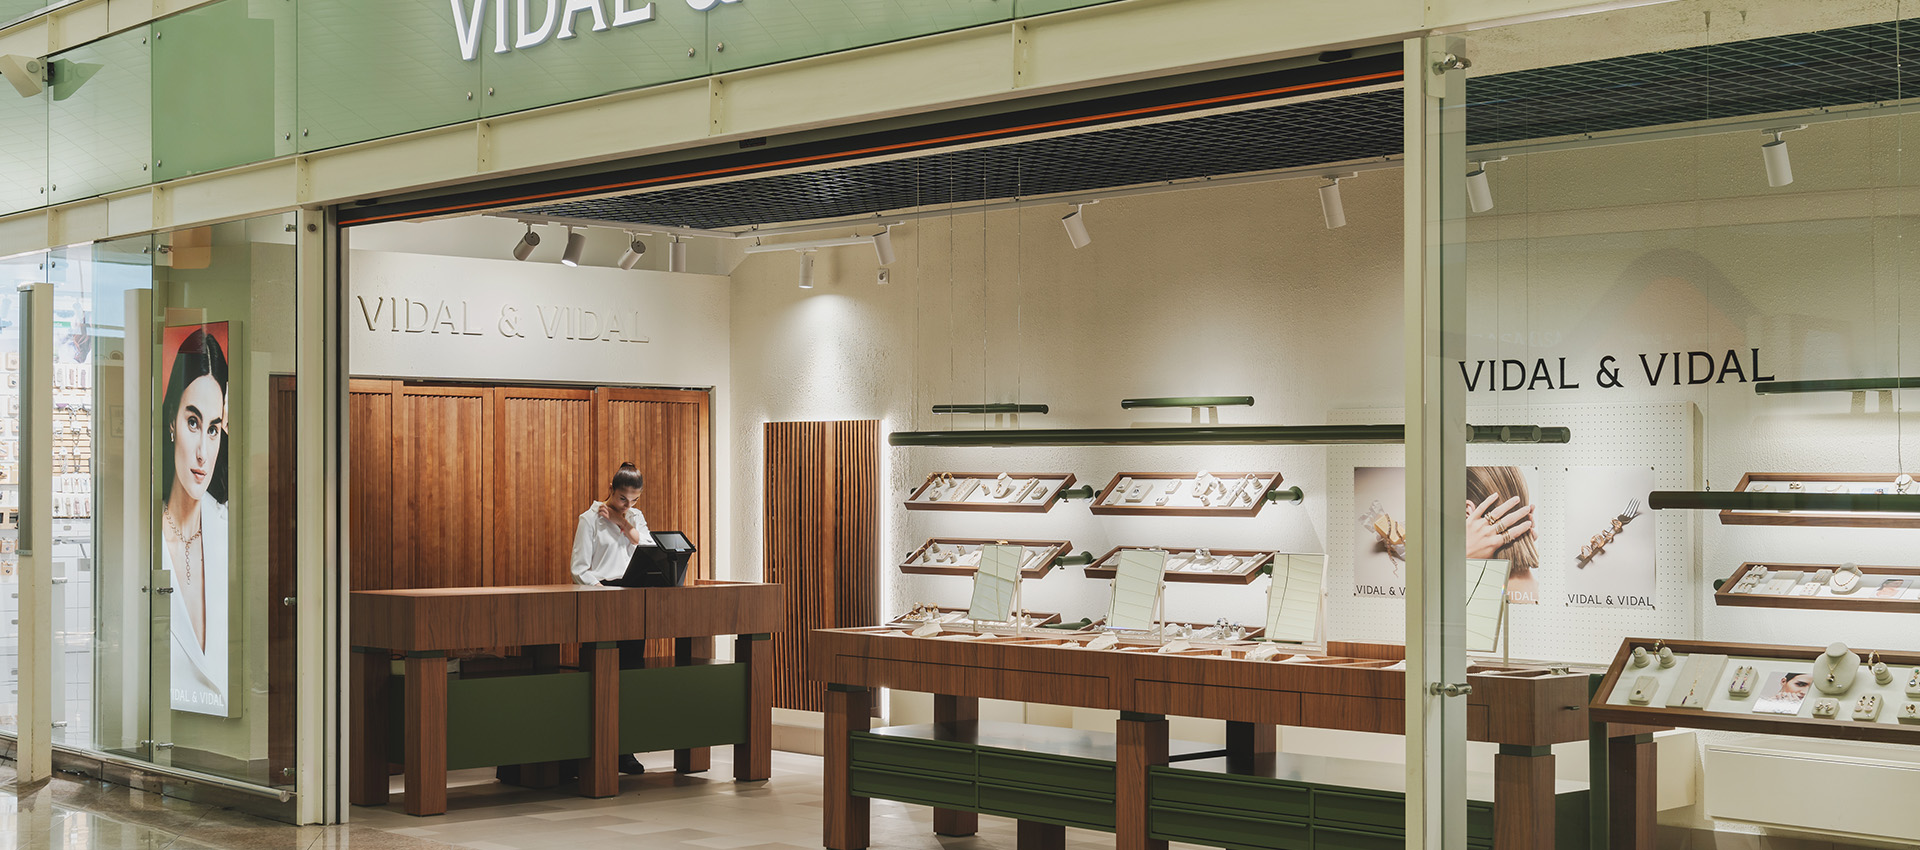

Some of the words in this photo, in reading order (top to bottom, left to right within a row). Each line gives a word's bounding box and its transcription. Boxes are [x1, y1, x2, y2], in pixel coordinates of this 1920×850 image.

[450, 0, 656, 61] VID
[357, 295, 483, 336] VIDAL
[497, 303, 525, 338] &
[536, 304, 650, 343] VIDAL
[1458, 357, 1580, 392] VIDAL
[1596, 355, 1625, 389] &
[1638, 348, 1776, 387] VIDAL
[1356, 585, 1386, 595] VIDAL
[1388, 586, 1396, 596] &
[1567, 594, 1602, 605] VIDAL
[1605, 595, 1614, 605] &
[1617, 596, 1653, 607] VIDAL
[191, 691, 198, 703] &
[199, 691, 224, 707] VIDAL
